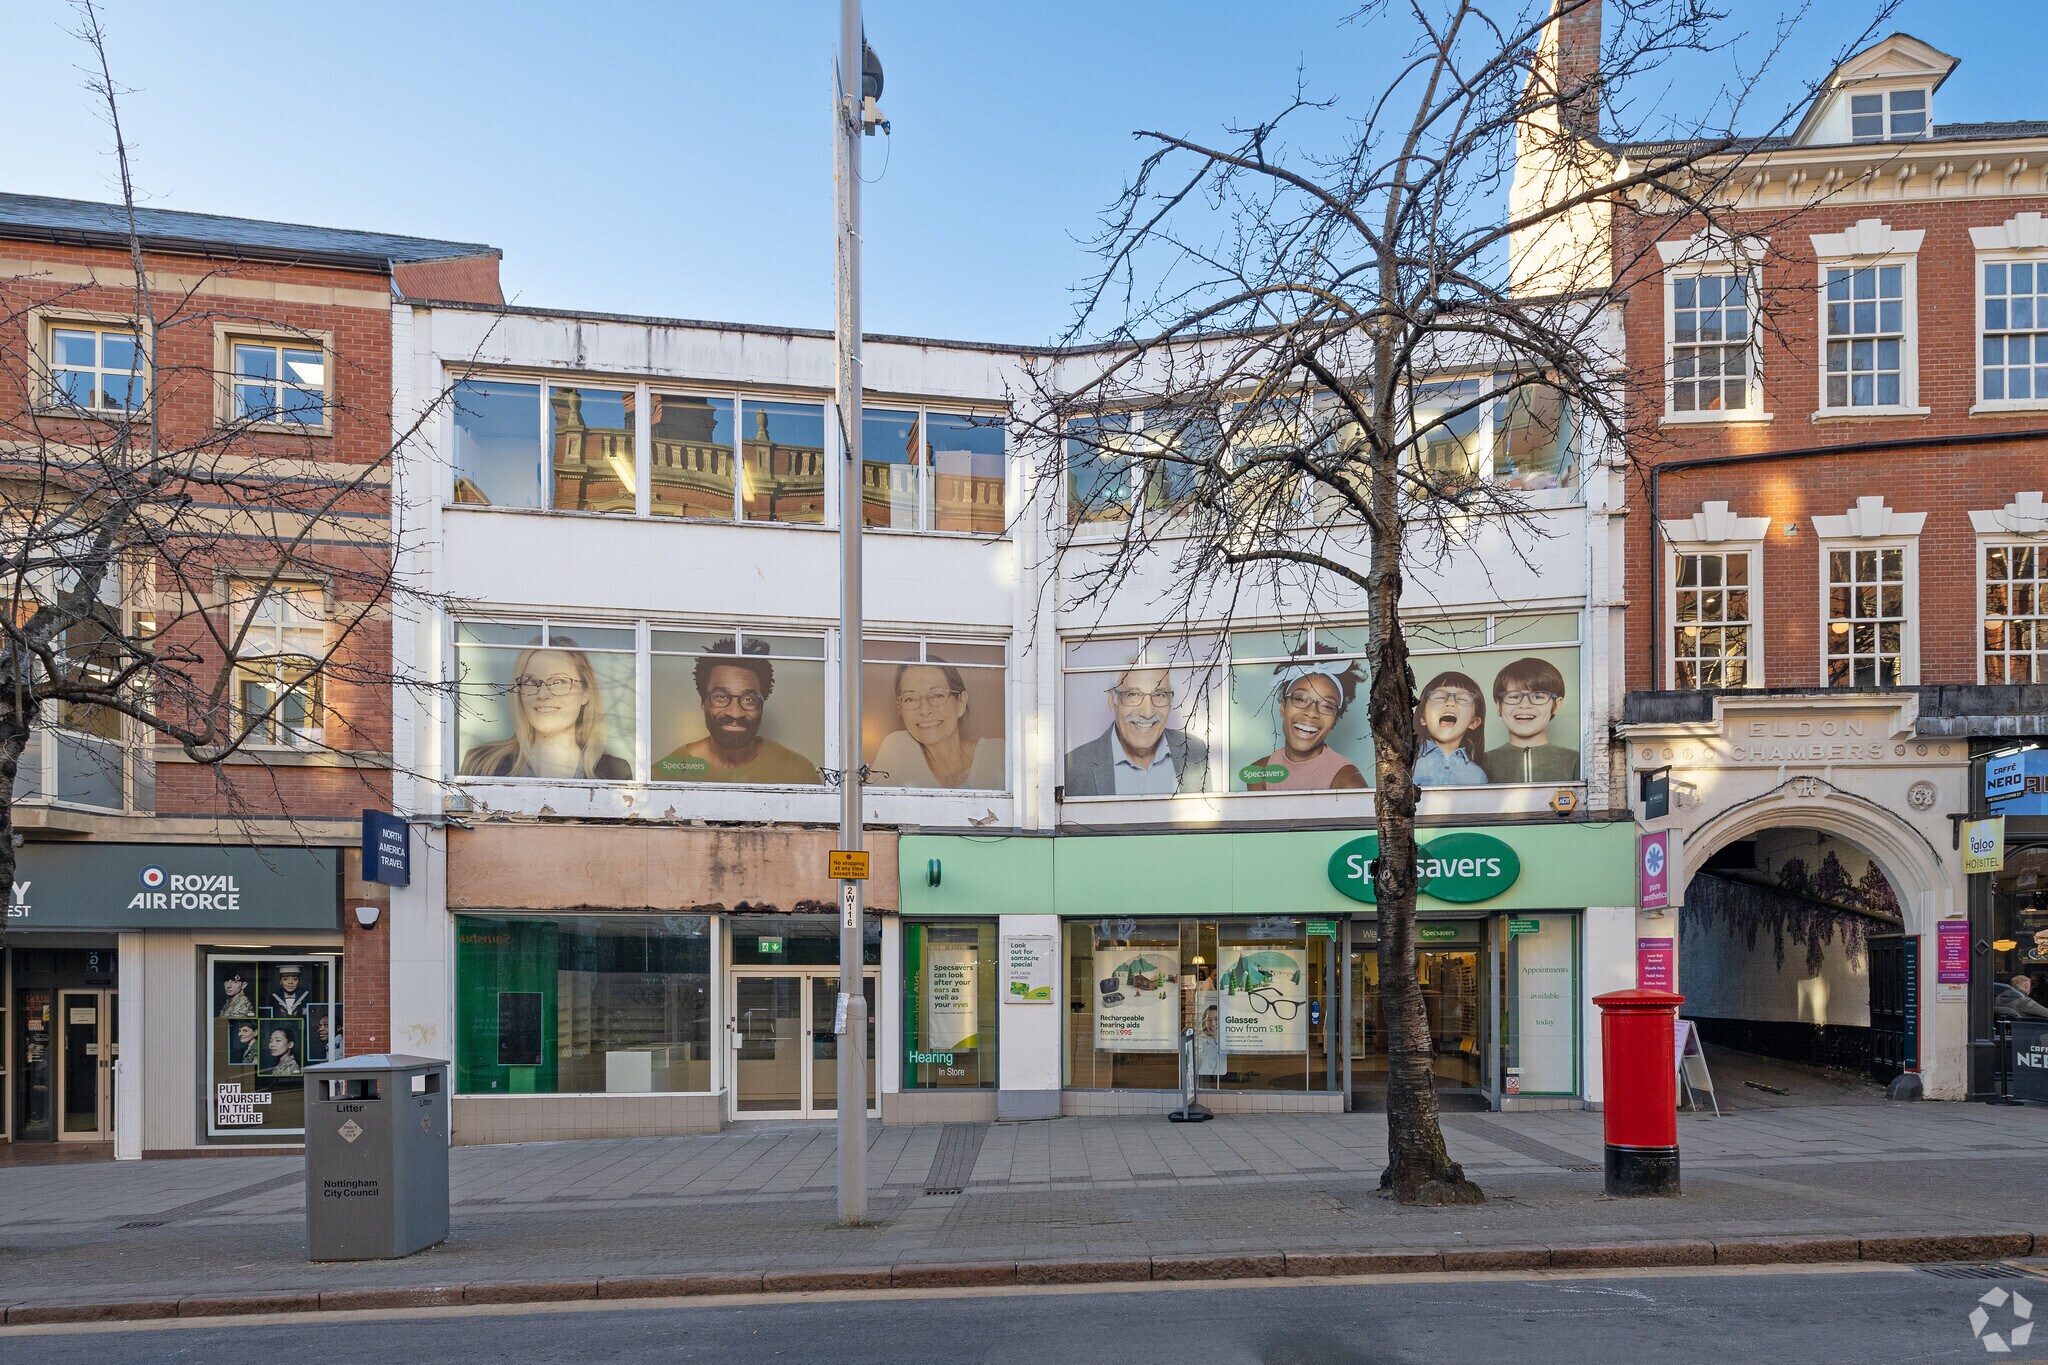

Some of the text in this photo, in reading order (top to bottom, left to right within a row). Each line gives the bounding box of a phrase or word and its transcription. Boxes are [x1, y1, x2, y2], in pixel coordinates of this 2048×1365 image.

[1750, 720, 1864, 737] ELDON
[1731, 743, 1884, 761] CHAMBERS
[663, 761, 705, 770] Specsavers
[1243, 770, 1285, 780] Specsavers
[1988, 774, 2021, 790] NERO
[383, 829, 402, 841] NORTH
[1971, 837, 1994, 853] igloo
[379, 843, 405, 857] AMERICA
[381, 856, 403, 869] TRAVEL
[1346, 854, 1500, 885] Spsavers
[171, 874, 240, 891] ROYAL
[1649, 883, 1661, 892] pure
[127, 892, 240, 910] AIR FORCE
[1643, 892, 1668, 902] aesthetics
[1423, 929, 1455, 937] Specsavers
[1522, 966, 1569, 976] Appointments
[1531, 992, 1560, 1000] available
[1225, 1016, 1258, 1024] Glasses
[1536, 1018, 1555, 1027] today
[1246, 1024, 1266, 1032] from
[909, 1051, 954, 1065] Hearing
[947, 1067, 965, 1076] Store
[220, 1085, 239, 1093] PUT
[220, 1094, 270, 1103] YOURSELF
[220, 1104, 252, 1113] IN THE
[337, 1105, 363, 1113] Litter
[220, 1114, 261, 1123] PICTURE
[324, 1180, 377, 1188] Nottingham
[324, 1189, 379, 1198] City Council
